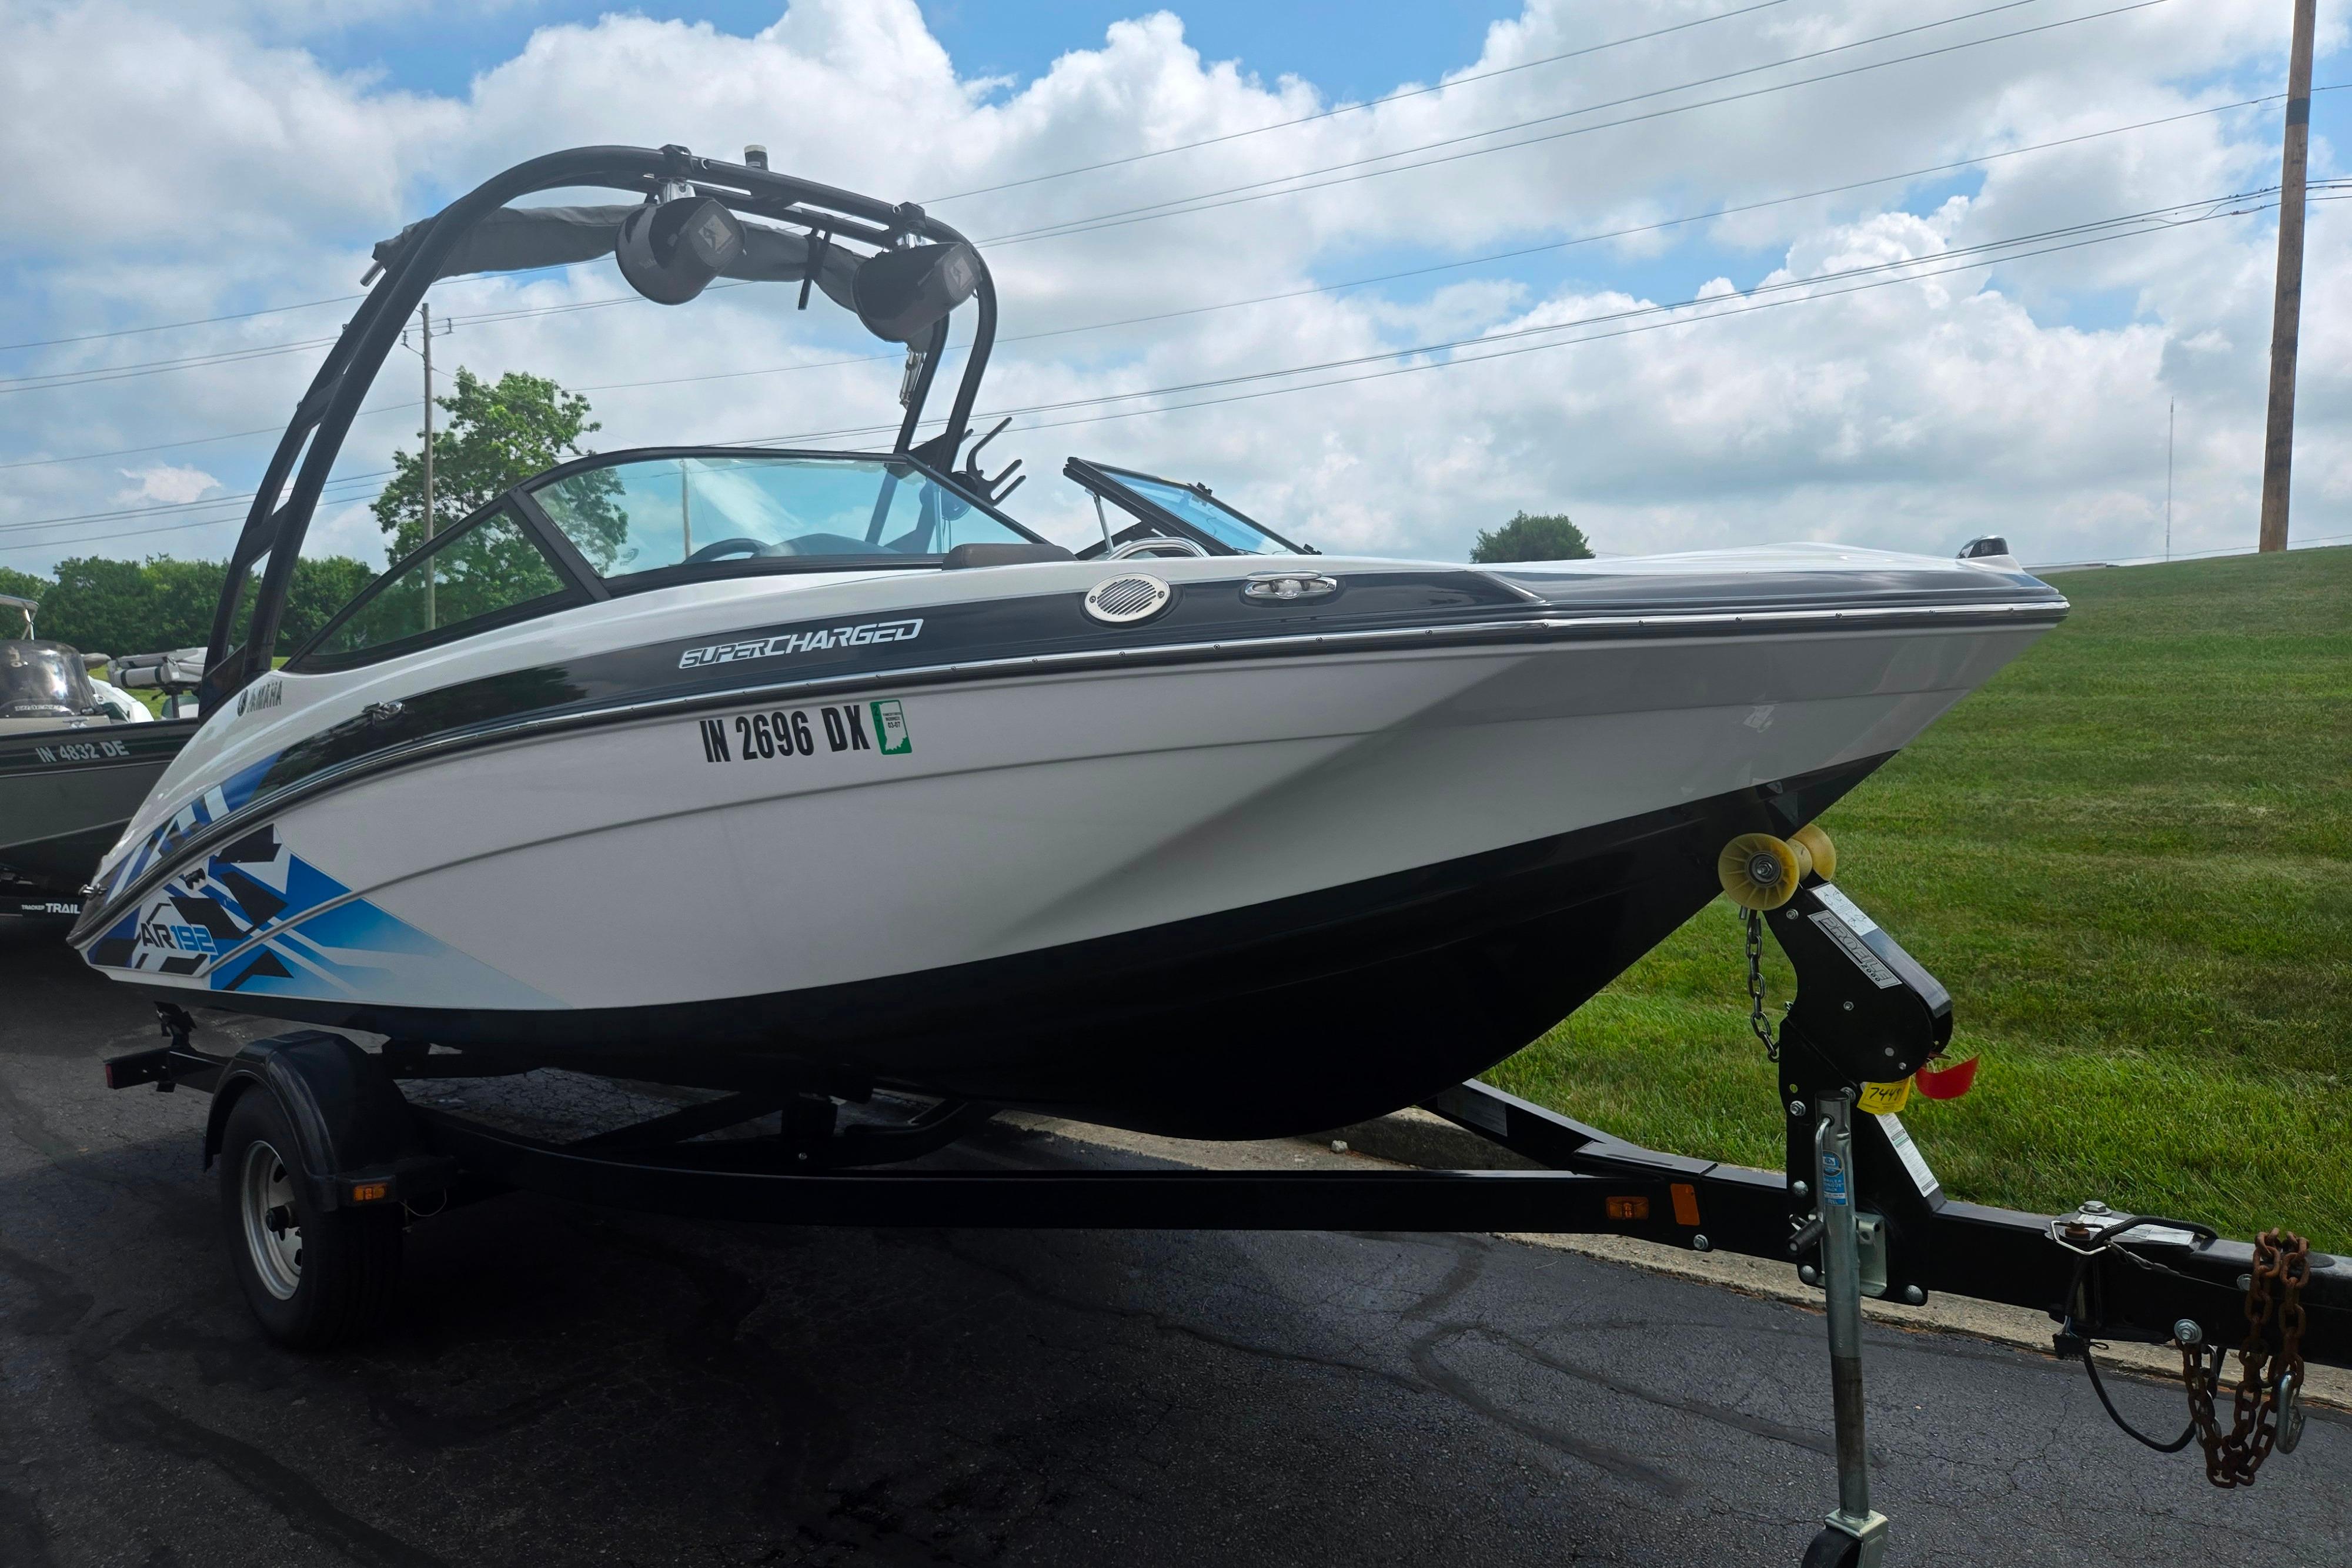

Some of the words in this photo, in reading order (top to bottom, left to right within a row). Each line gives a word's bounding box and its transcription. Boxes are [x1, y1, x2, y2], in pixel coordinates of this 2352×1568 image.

[679, 618, 924, 669] SUPERCHARGED
[35, 747, 57, 763] IN
[59, 744, 101, 761] 4832
[99, 740, 130, 757] DE
[700, 720, 731, 763] IN
[736, 710, 814, 761] 2696
[821, 705, 870, 752] DX
[1821, 917, 1892, 981] PROFILE
[1861, 964, 1881, 982] 2000
